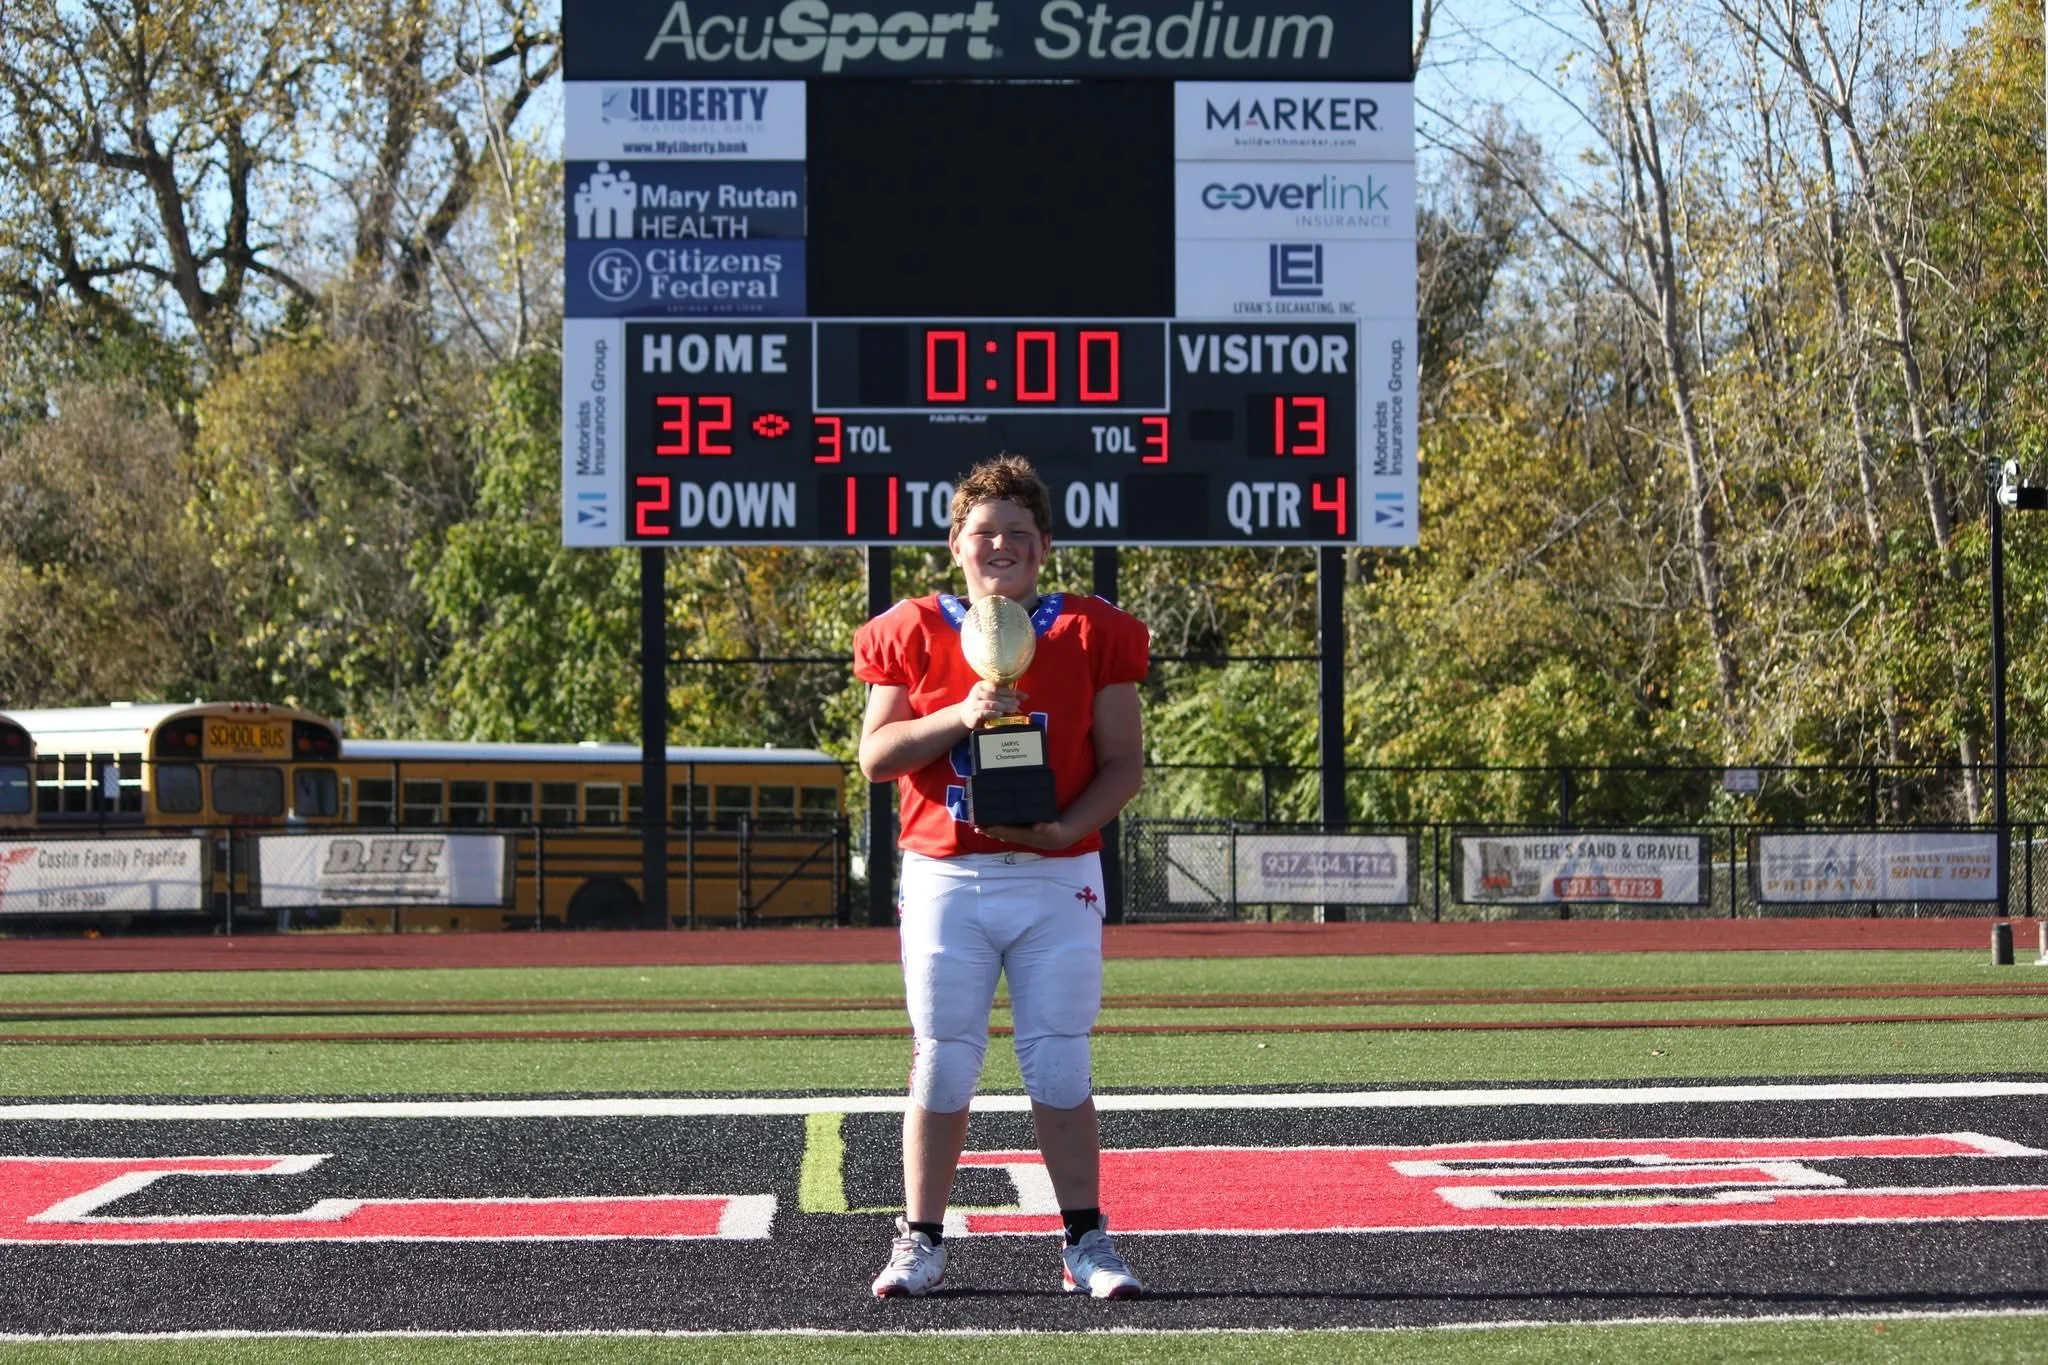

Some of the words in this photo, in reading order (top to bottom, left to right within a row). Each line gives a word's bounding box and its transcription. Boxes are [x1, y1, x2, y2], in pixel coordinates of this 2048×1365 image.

[645, 0, 1000, 73] AcuSport
[1034, 0, 1335, 60] Stadium
[640, 86, 769, 122] LIBERTY
[1206, 97, 1379, 131] MARKER
[642, 184, 710, 213] Mary
[718, 184, 798, 208] Rutan
[1201, 174, 1389, 211] coverlink
[641, 215, 749, 239] HEALTH
[1295, 215, 1391, 228] INSURANCE
[645, 248, 783, 274] Citizens
[650, 274, 780, 300] Federal
[591, 338, 608, 393] Group
[642, 334, 788, 374] HOME
[1178, 334, 1349, 375] VISITOR
[1388, 338, 1405, 393] Group
[576, 399, 591, 476] Motorists
[592, 395, 606, 476] Insurance
[656, 396, 732, 455] 32
[814, 417, 842, 463] 3
[847, 425, 892, 454] TOL
[1091, 425, 1136, 454] TOL
[1141, 417, 1169, 463] 3
[1275, 396, 1326, 455] 13
[1373, 399, 1388, 476] Motorists
[1389, 395, 1403, 476] Insurance
[636, 476, 670, 535] 2
[679, 481, 796, 528] DOWN
[846, 476, 898, 535] 11
[1065, 481, 1119, 528] ON
[1226, 481, 1302, 535] QTR
[1312, 477, 1346, 535] 4
[209, 724, 257, 747] SCHOOL
[260, 727, 285, 749] BUS
[995, 753, 1028, 761] Champions
[83, 847, 128, 872] Family
[132, 846, 187, 867] Practice
[1523, 843, 1573, 861] NEER'S
[1578, 843, 1616, 860] SAND
[1622, 843, 1631, 859] &
[1637, 843, 1693, 861] GRAVEL
[1889, 866, 1944, 880] SINCE
